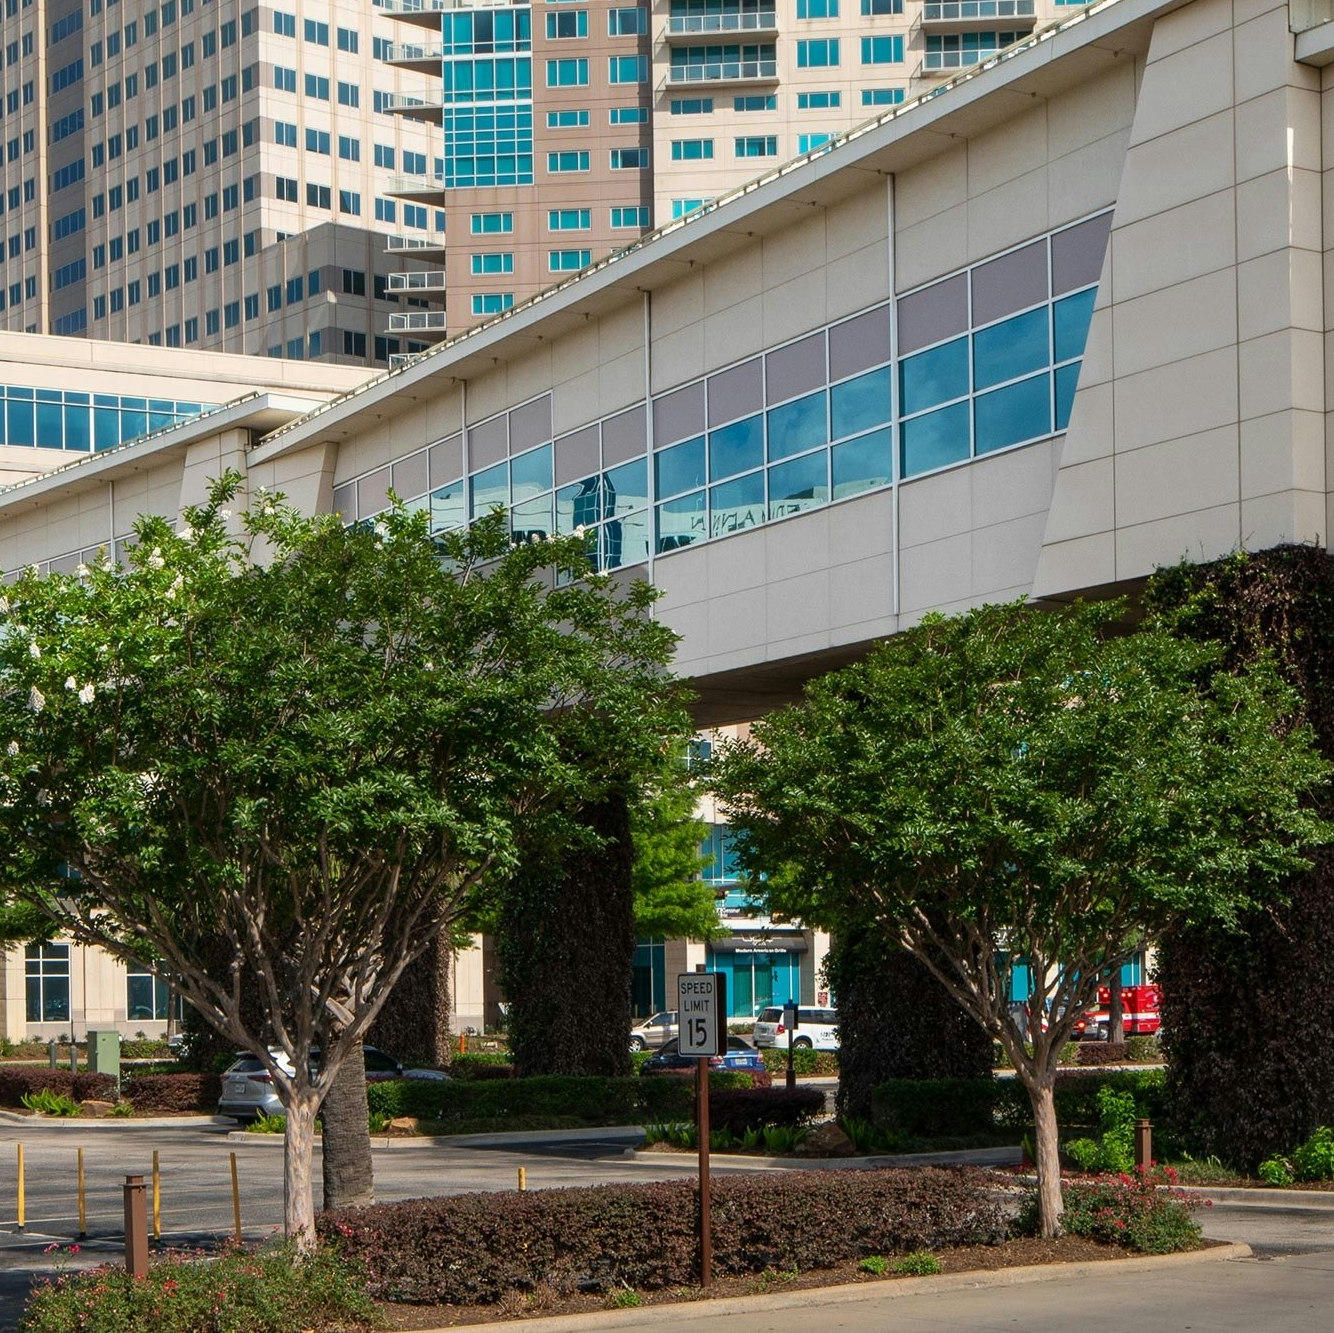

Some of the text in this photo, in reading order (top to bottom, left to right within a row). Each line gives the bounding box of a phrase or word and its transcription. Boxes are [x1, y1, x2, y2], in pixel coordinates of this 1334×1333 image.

[681, 982, 713, 994] SPEED
[684, 1000, 710, 1012] LIMIT
[688, 1018, 707, 1047] 15
